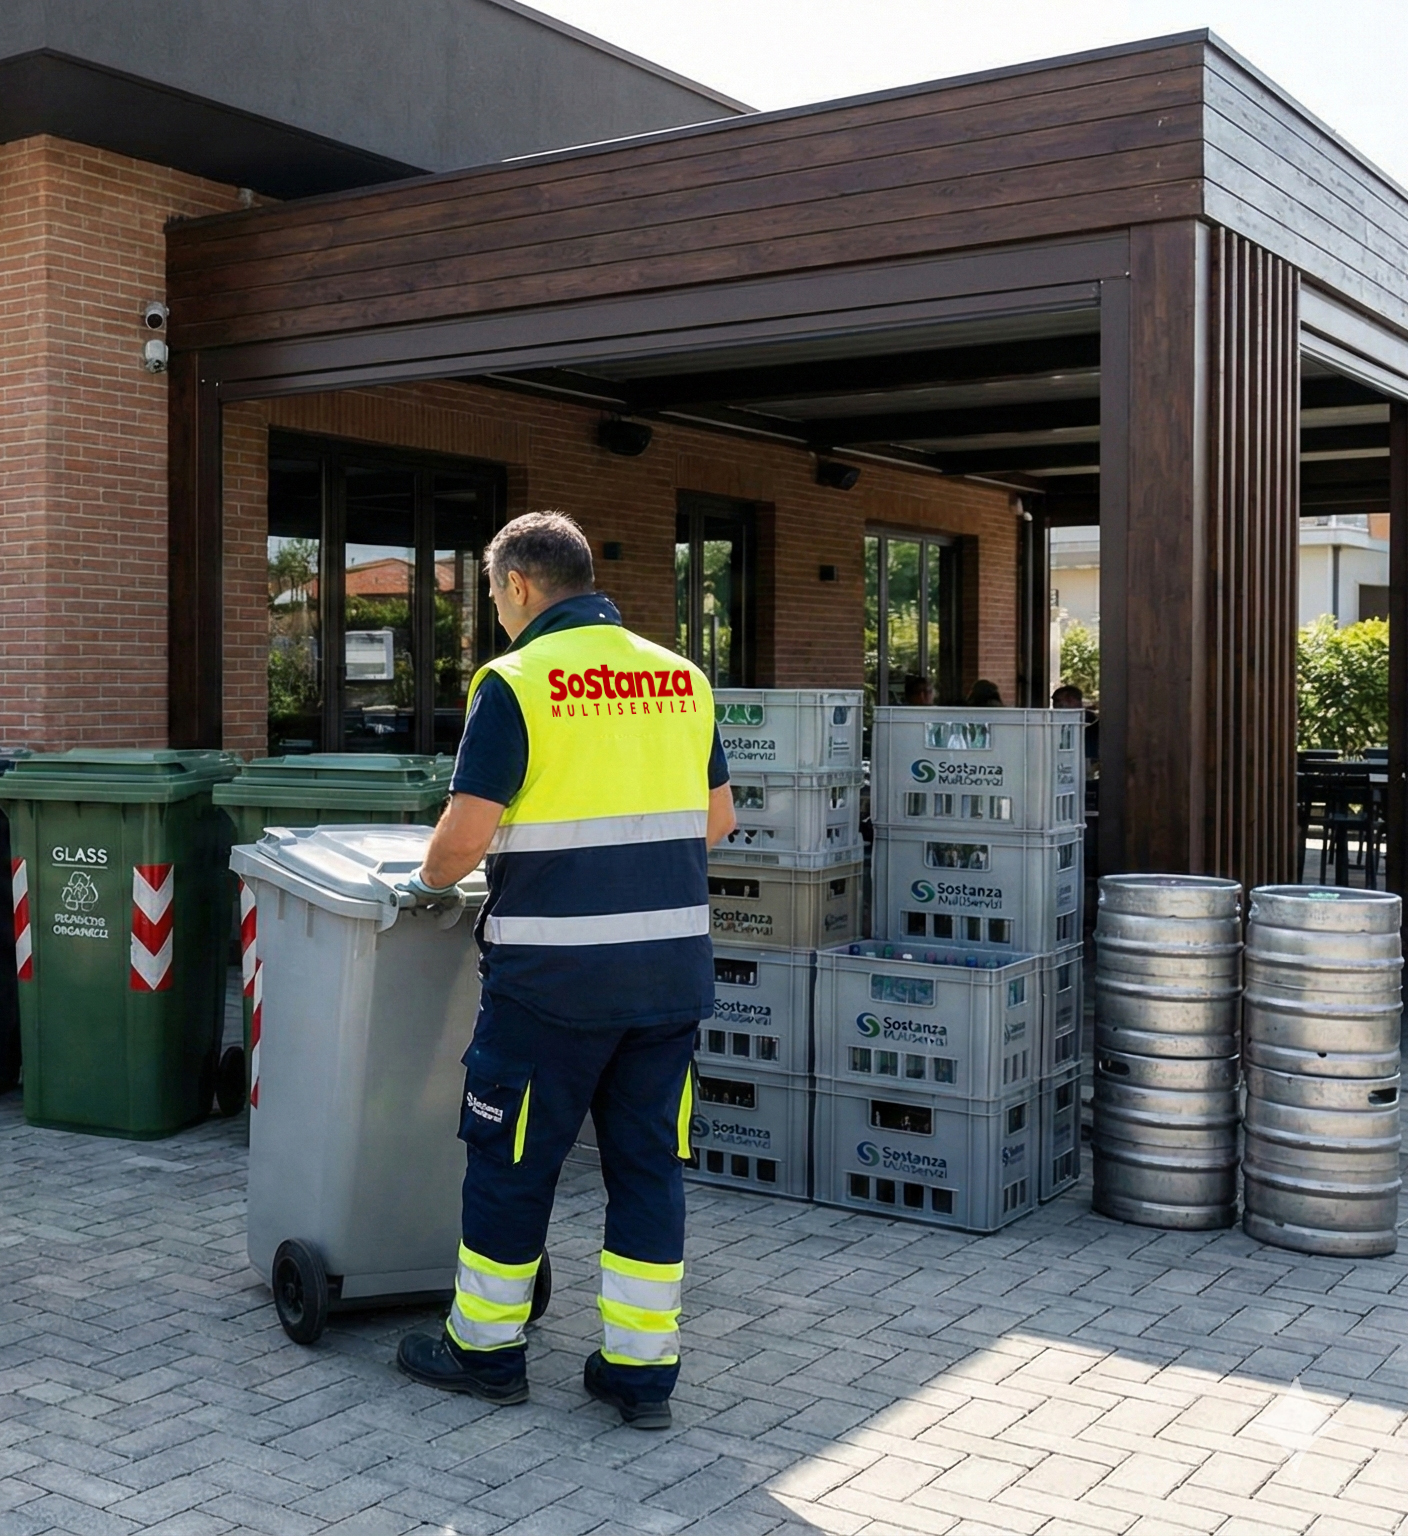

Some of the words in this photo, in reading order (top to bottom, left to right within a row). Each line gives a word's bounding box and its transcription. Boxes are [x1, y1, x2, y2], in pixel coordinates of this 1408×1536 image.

[551, 700, 697, 718] MULTISERVIZI
[722, 737, 776, 750] ostanza
[938, 761, 1003, 776] Sostanza
[52, 846, 108, 864] GLASS
[937, 882, 1003, 899] Sostanza
[714, 998, 772, 1016] Sostanza
[712, 1119, 771, 1139] Sostanza
